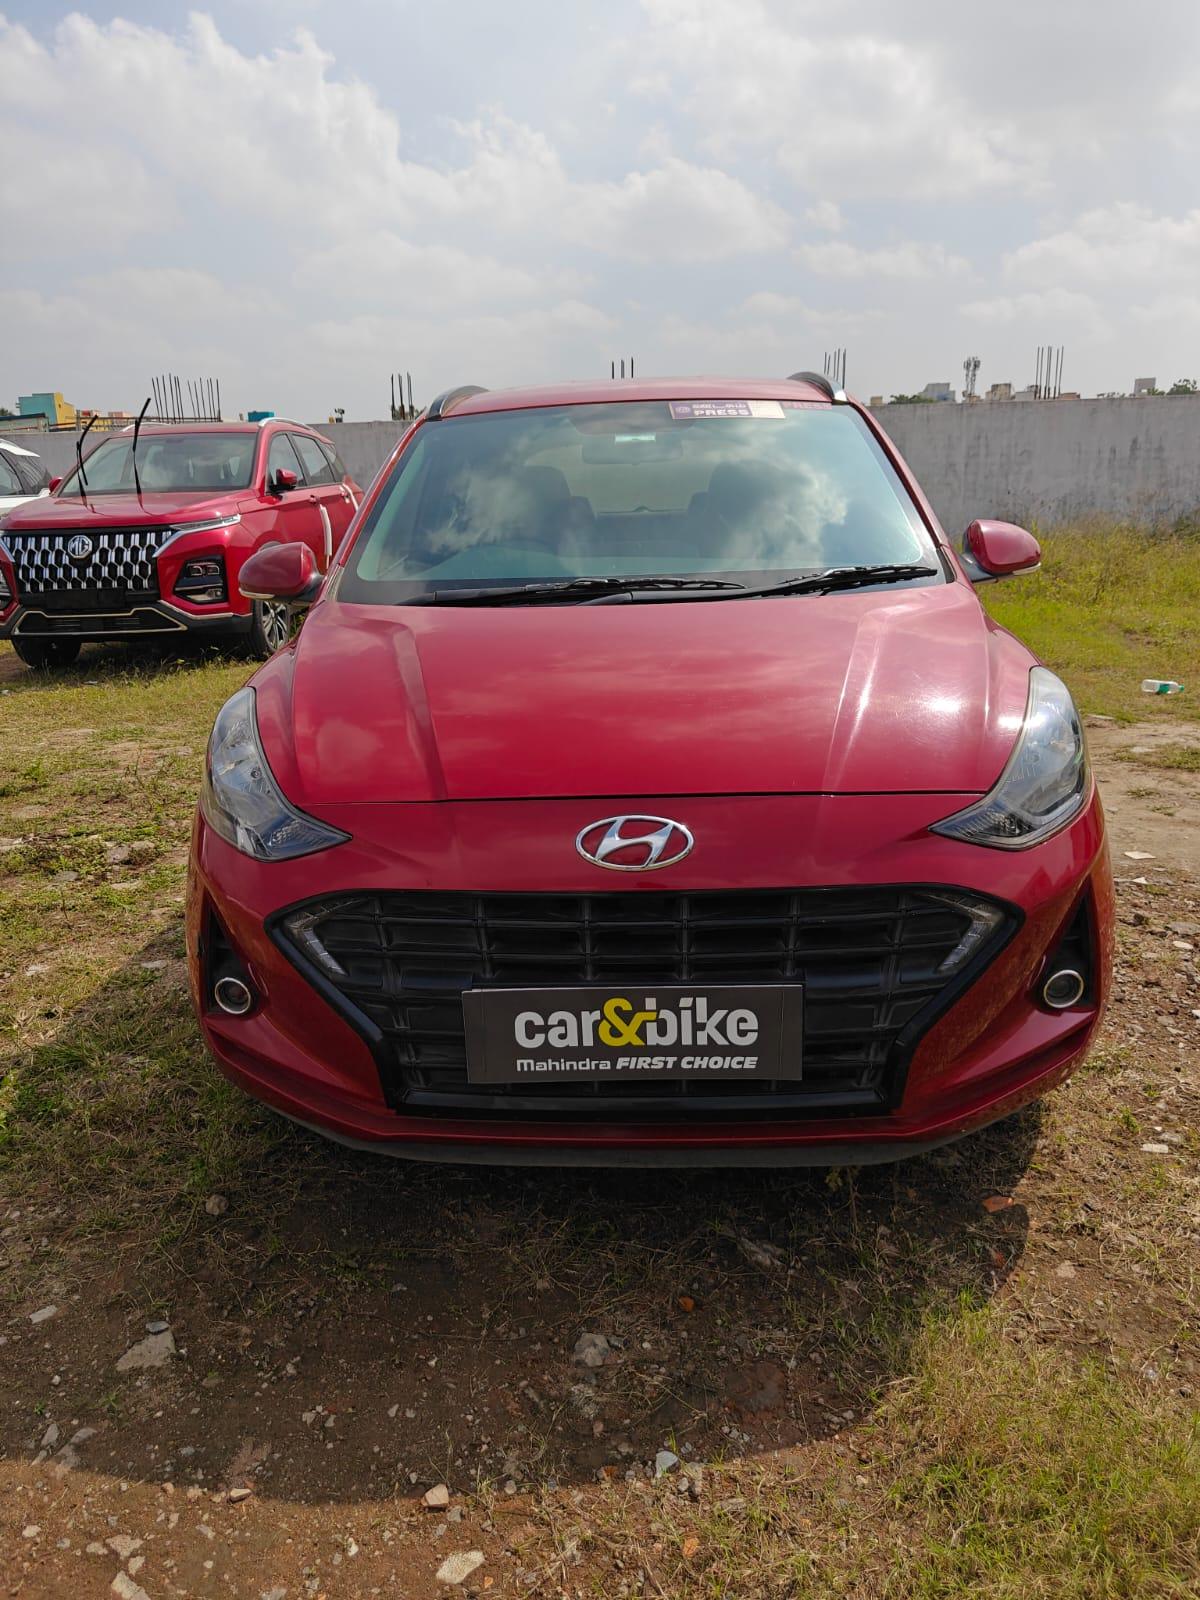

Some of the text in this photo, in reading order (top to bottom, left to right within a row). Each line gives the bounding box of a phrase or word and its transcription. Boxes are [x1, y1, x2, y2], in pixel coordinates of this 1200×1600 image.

[69, 536, 91, 557] MG
[514, 997, 759, 1049] car&bike
[516, 1056, 759, 1072] Mahindra FIRST CHOICE
